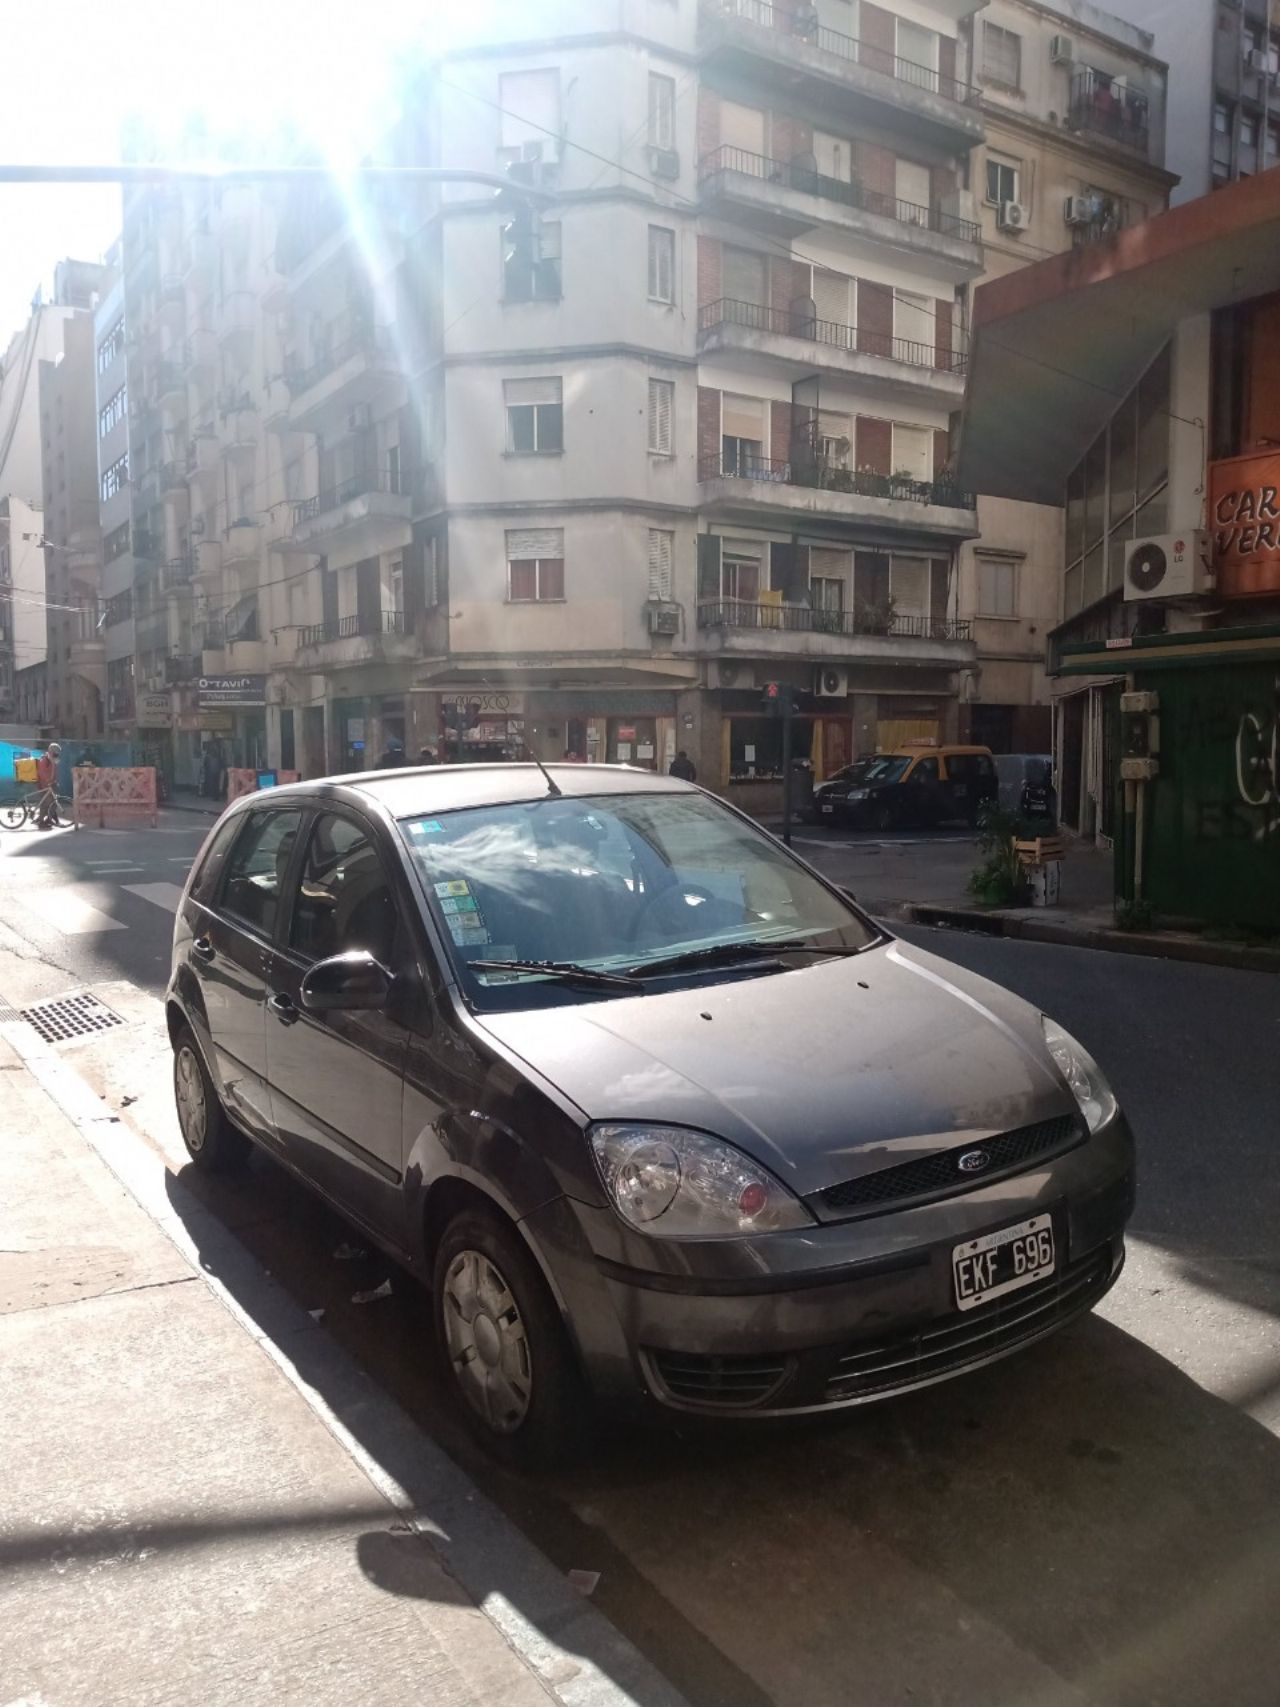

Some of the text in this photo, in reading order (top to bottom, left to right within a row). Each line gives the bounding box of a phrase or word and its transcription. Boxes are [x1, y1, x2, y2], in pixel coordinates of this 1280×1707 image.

[1216, 522, 1280, 556] VER
[1174, 555, 1184, 563] LG
[959, 1232, 1051, 1297] EKF 696
